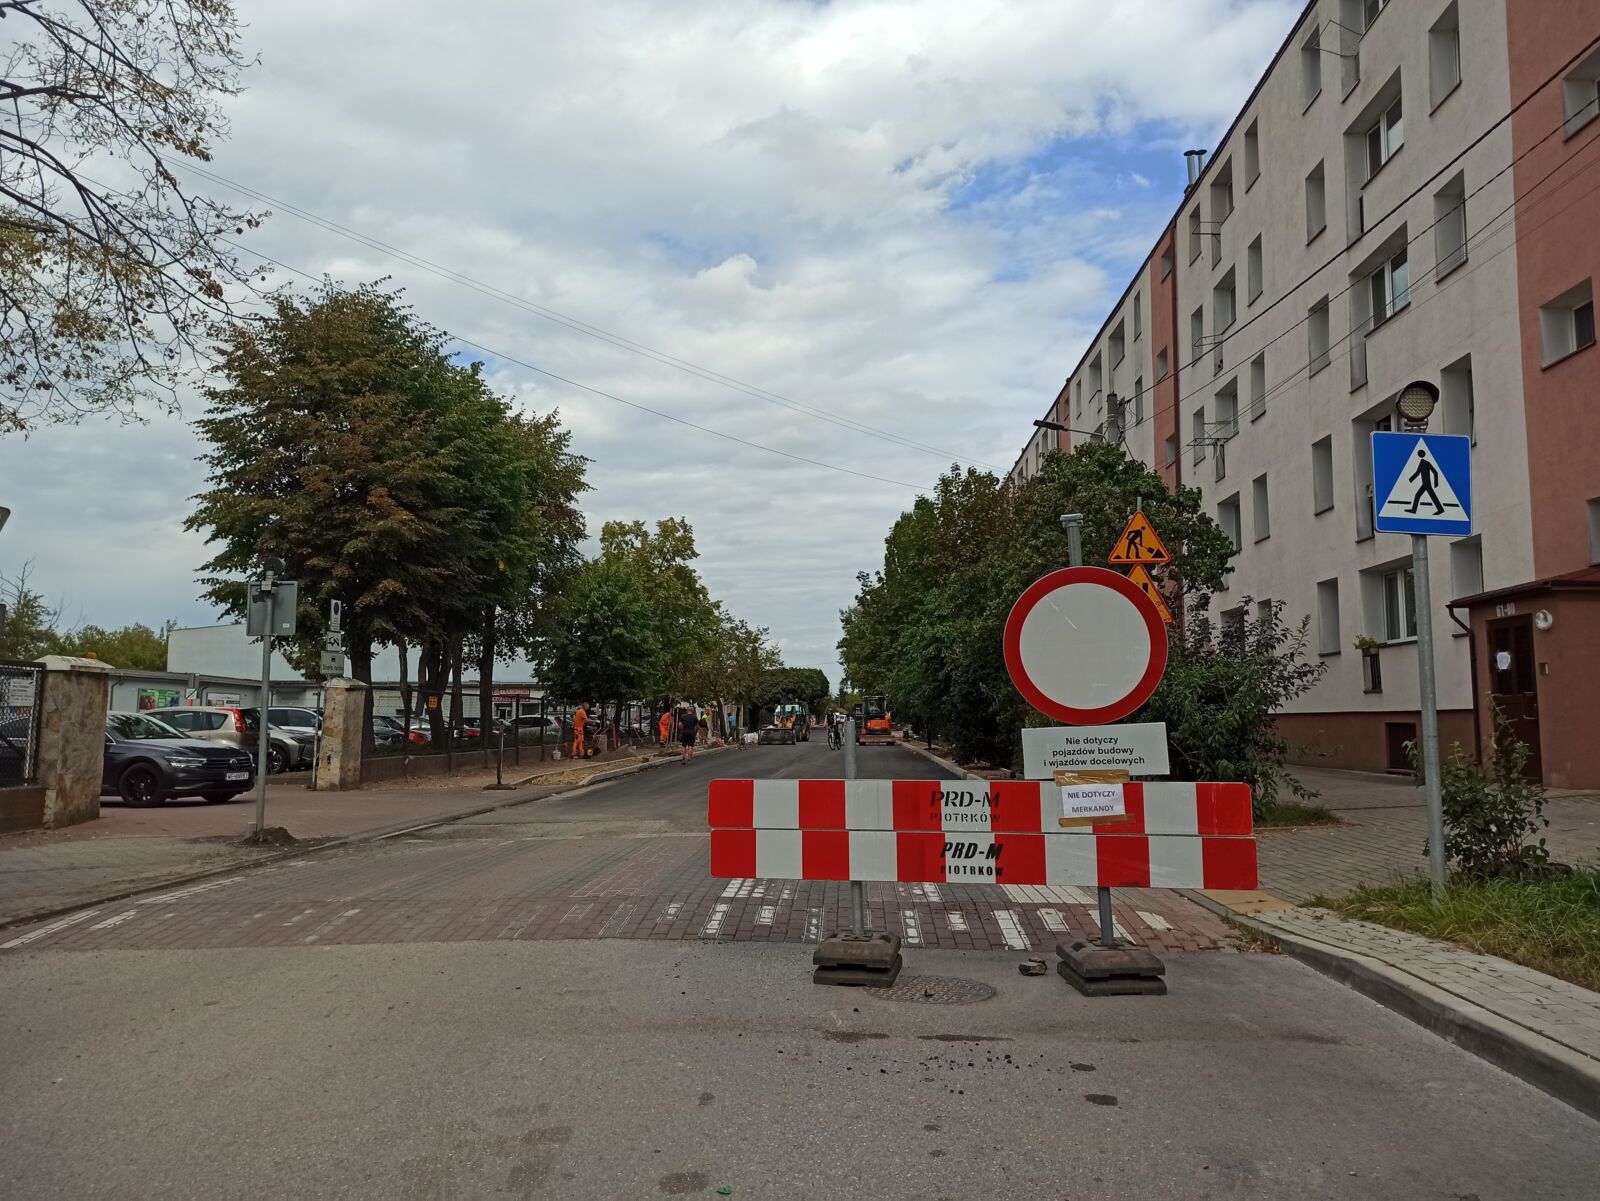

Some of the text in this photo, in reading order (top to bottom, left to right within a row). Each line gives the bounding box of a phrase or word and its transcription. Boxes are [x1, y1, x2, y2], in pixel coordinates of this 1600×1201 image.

[1065, 736, 1119, 746] Nie dotyczy
[1052, 747, 1134, 758] pojazdów budowy
[1048, 758, 1087, 768] wjazdów
[1089, 756, 1145, 767] docelowych
[930, 791, 1001, 808] PRD-M
[1067, 790, 1116, 799] NIE DOTYCZY
[1071, 805, 1115, 813] MERKANDY
[940, 841, 1004, 860] PRD-M
